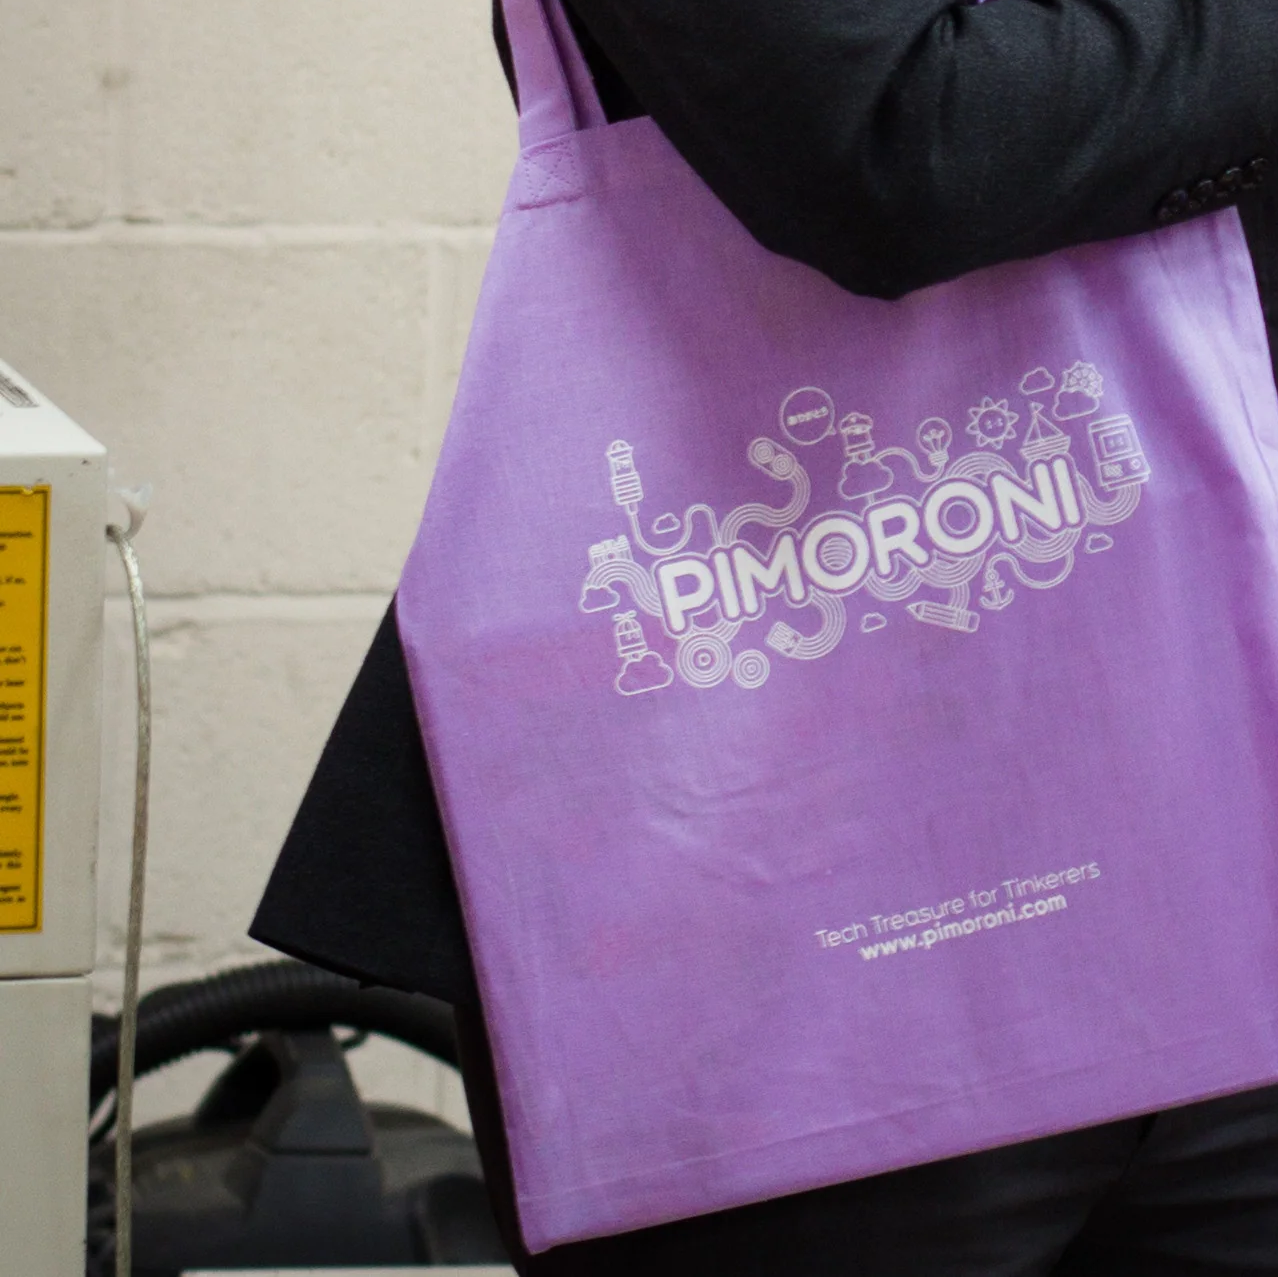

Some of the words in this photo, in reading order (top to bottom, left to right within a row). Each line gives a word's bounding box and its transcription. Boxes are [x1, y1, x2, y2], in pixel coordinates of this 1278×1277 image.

[658, 457, 1080, 632] PIMORONI
[815, 920, 868, 949] Tech
[870, 898, 965, 935] Treasure
[968, 887, 998, 908] for
[1001, 861, 1101, 901] Tinkerers
[858, 893, 1068, 961] www.pimoroni.com
